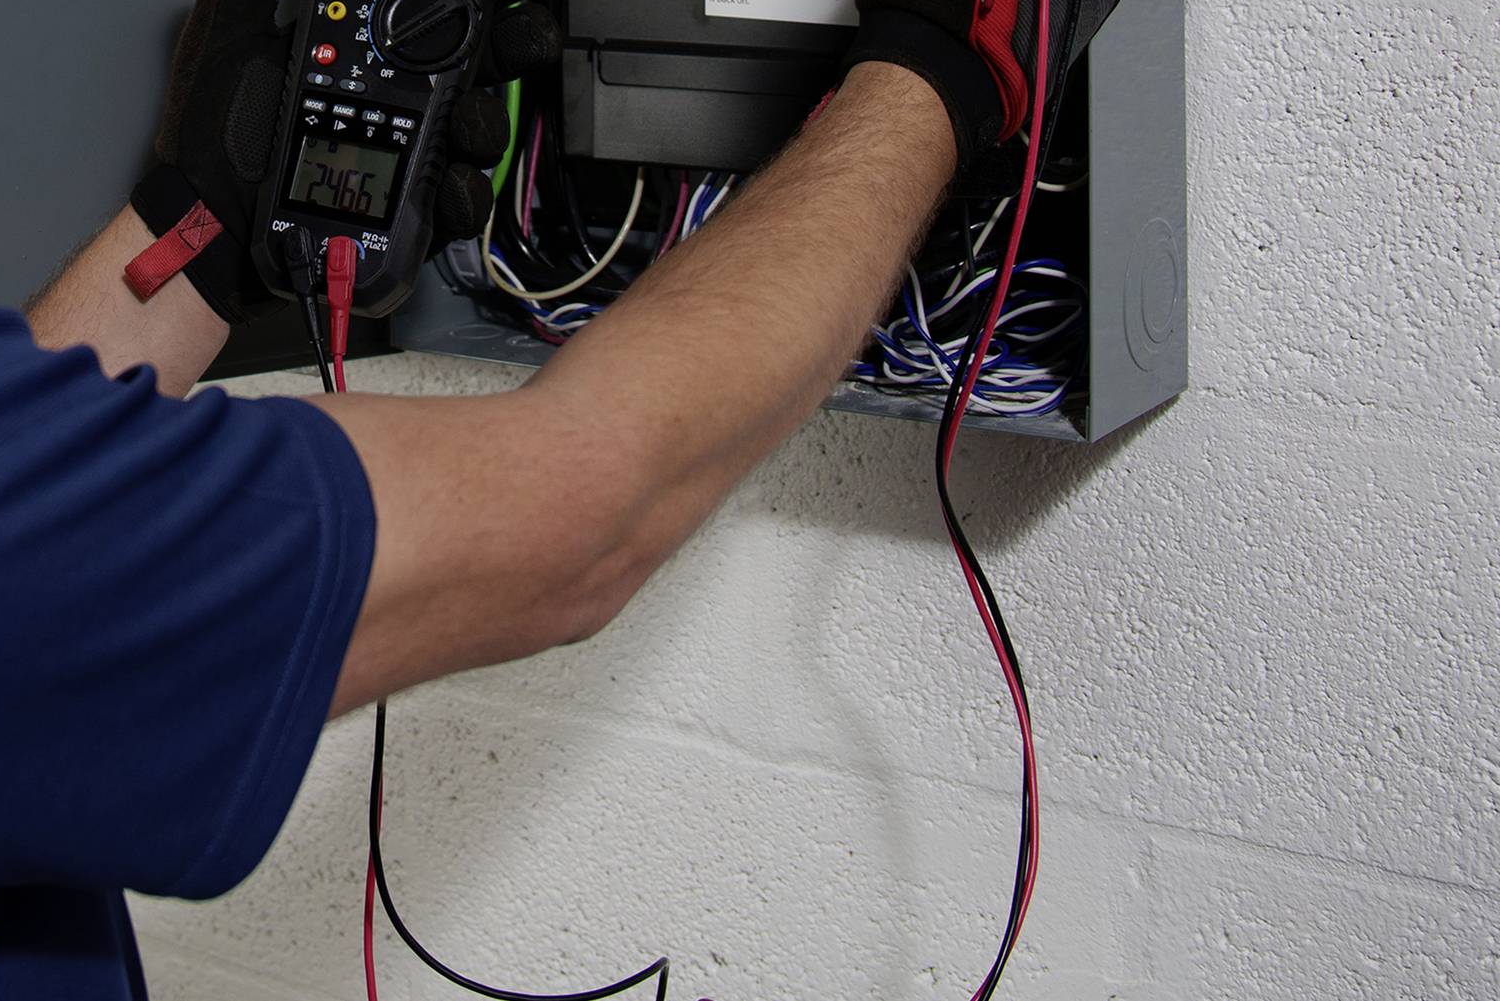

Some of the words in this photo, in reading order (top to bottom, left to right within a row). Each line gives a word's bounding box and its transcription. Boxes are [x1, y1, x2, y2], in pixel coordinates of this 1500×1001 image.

[380, 68, 395, 78] OFF
[305, 100, 324, 110] MODE
[333, 105, 354, 116] RANGE
[367, 113, 379, 121] LOG
[393, 117, 412, 128] HOLD
